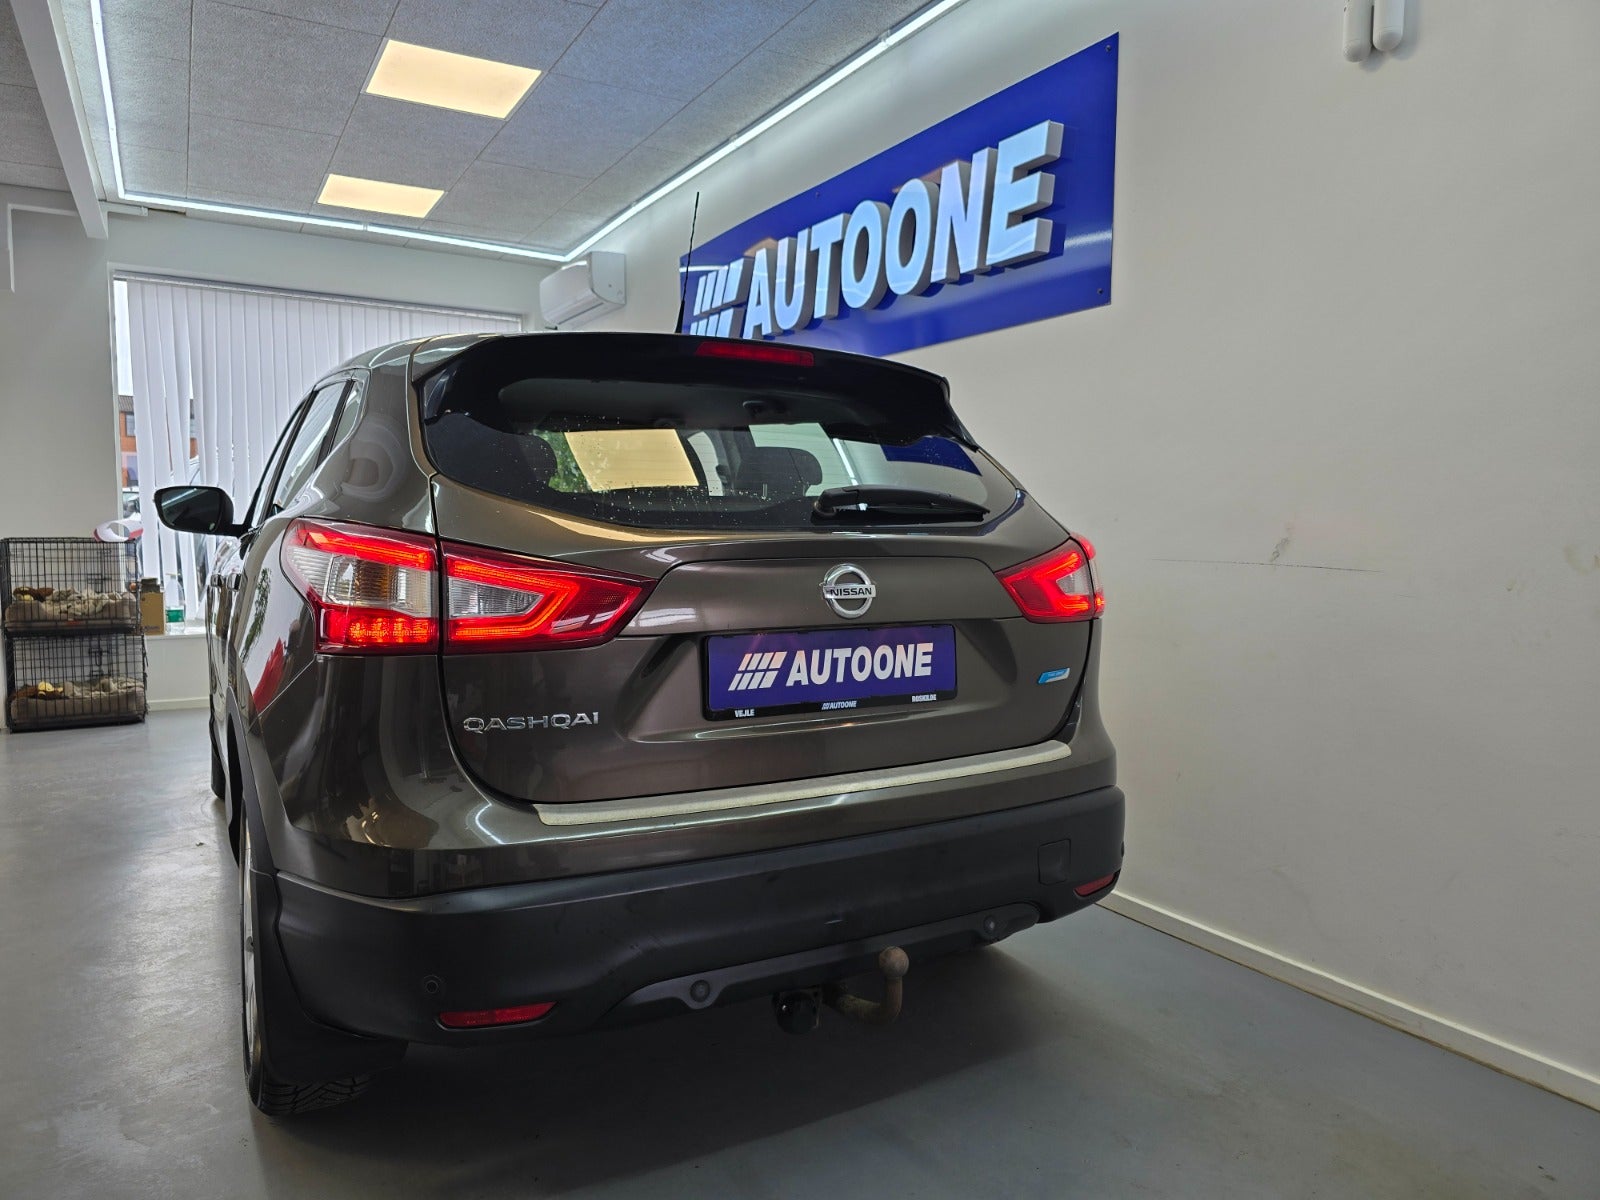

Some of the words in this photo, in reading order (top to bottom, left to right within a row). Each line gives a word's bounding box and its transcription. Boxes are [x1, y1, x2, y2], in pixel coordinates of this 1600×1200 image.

[743, 120, 1064, 339] AUTOONE
[830, 587, 872, 596] NISSAN
[785, 642, 934, 687] AUTOONE
[829, 700, 857, 709] AUTOONE
[734, 708, 755, 718] VEJLE
[463, 711, 599, 734] QASHQAI
